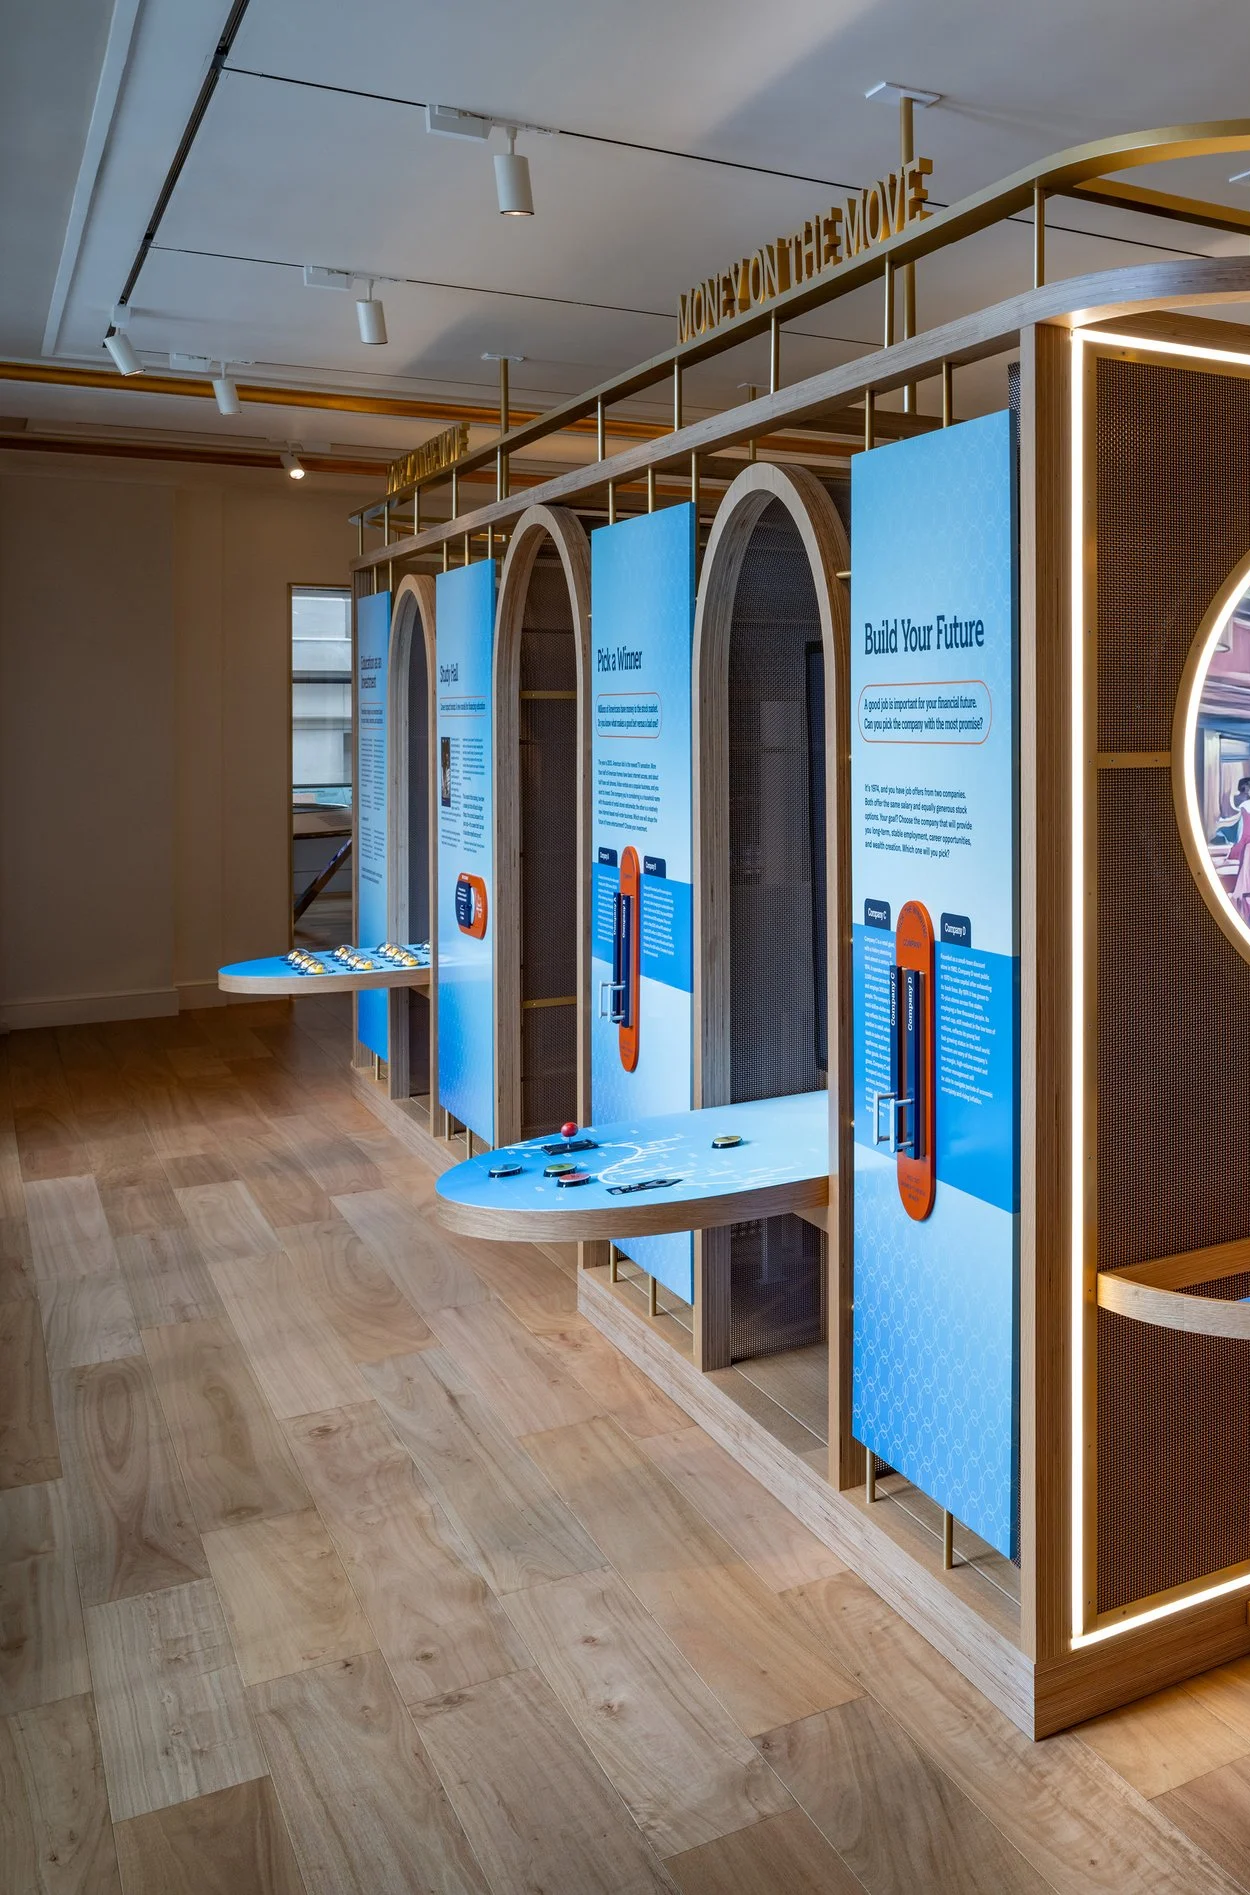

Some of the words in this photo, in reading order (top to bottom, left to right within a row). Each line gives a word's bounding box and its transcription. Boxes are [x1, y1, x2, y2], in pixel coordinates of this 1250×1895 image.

[677, 258, 750, 345] MONEY
[749, 237, 791, 305] ON
[786, 206, 843, 285] THE
[842, 157, 933, 258] MOVE
[864, 619, 898, 655] Build
[900, 618, 932, 652] Your
[936, 614, 984, 650] Future
[598, 648, 611, 672] Pick
[612, 653, 616, 671] a
[617, 646, 642, 670] Winner
[440, 664, 450, 688] Study
[868, 698, 880, 712] good
[889, 698, 893, 710] is
[894, 698, 918, 712] important
[926, 699, 937, 712] your
[938, 696, 960, 709] financial
[960, 696, 977, 708] future.
[864, 718, 873, 730] Can
[873, 720, 882, 732] you
[882, 718, 892, 732] pick
[893, 718, 901, 730] the
[902, 720, 924, 732] company
[924, 717, 935, 730] with
[936, 717, 944, 730] the
[945, 718, 958, 730] most
[959, 717, 984, 732] promise?
[868, 908, 884, 920] Company
[884, 911, 887, 920] C
[945, 923, 963, 937] Company
[963, 926, 966, 936] D
